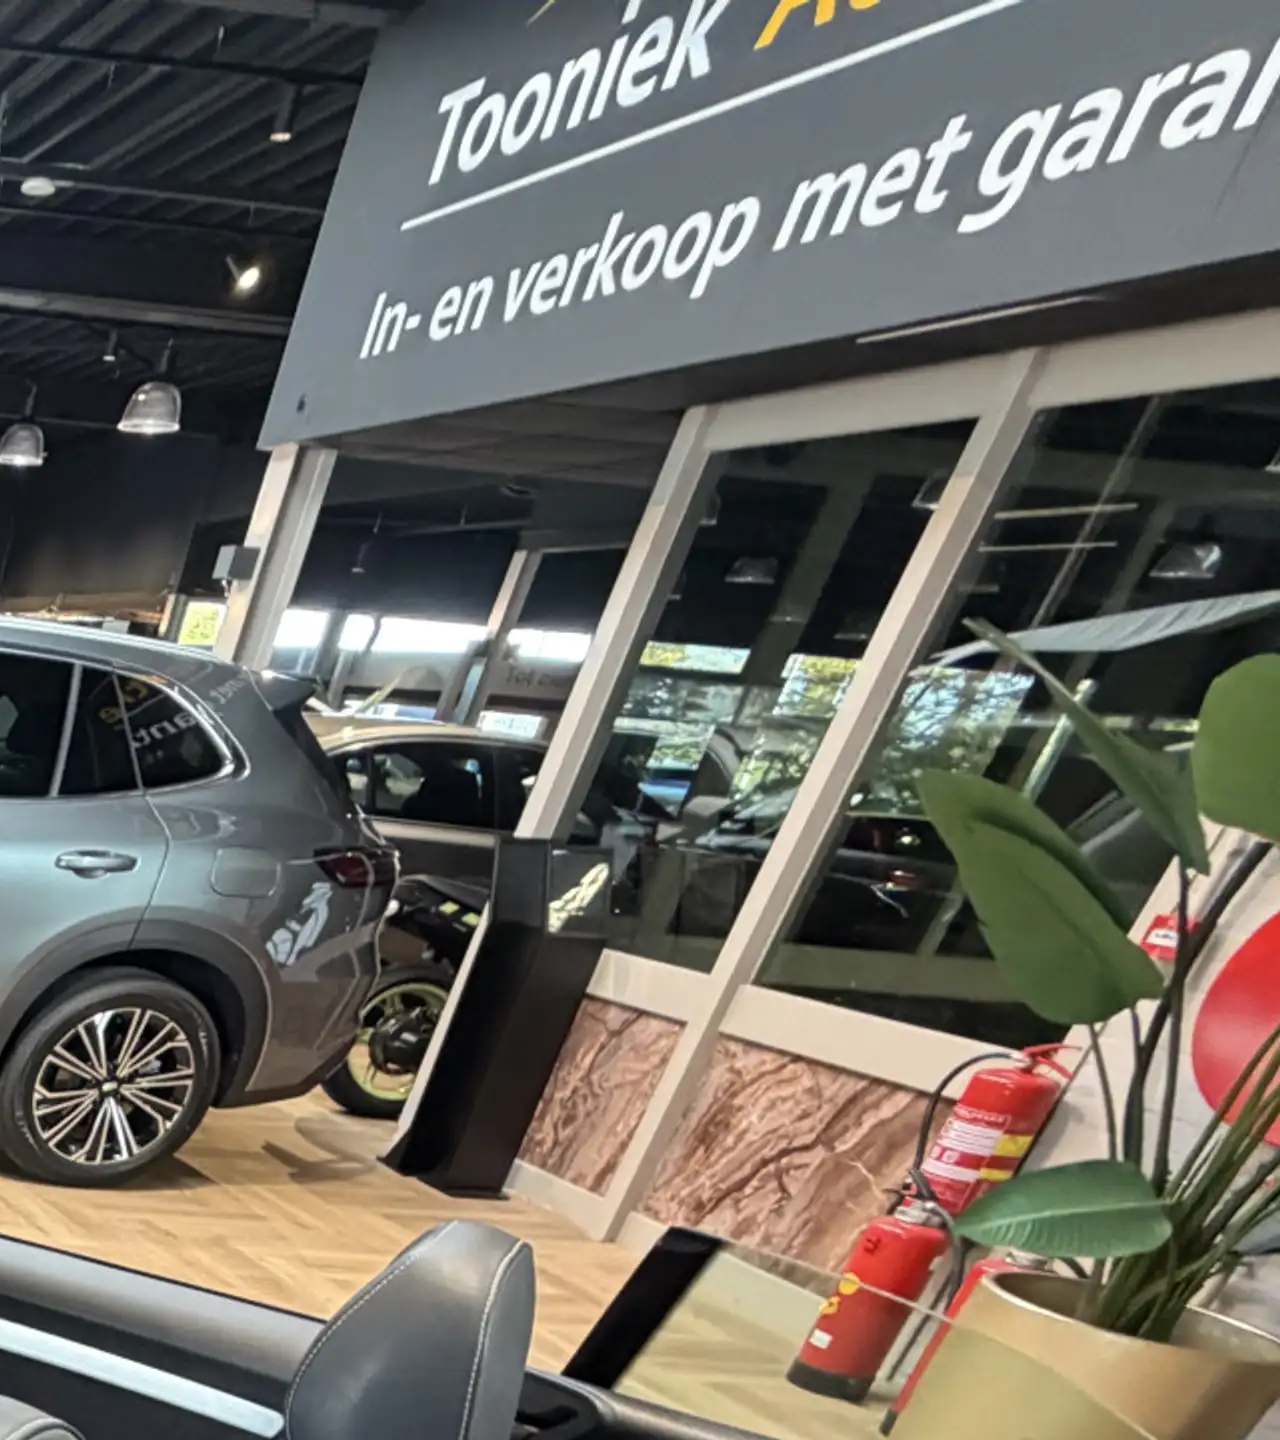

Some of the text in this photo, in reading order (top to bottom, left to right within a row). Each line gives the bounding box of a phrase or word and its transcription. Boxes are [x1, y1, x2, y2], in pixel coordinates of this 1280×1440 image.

[427, 0, 730, 186] Tooniek
[359, 291, 422, 360] In-
[428, 275, 495, 342] en
[502, 196, 761, 299] verkoop
[771, 113, 973, 252] met
